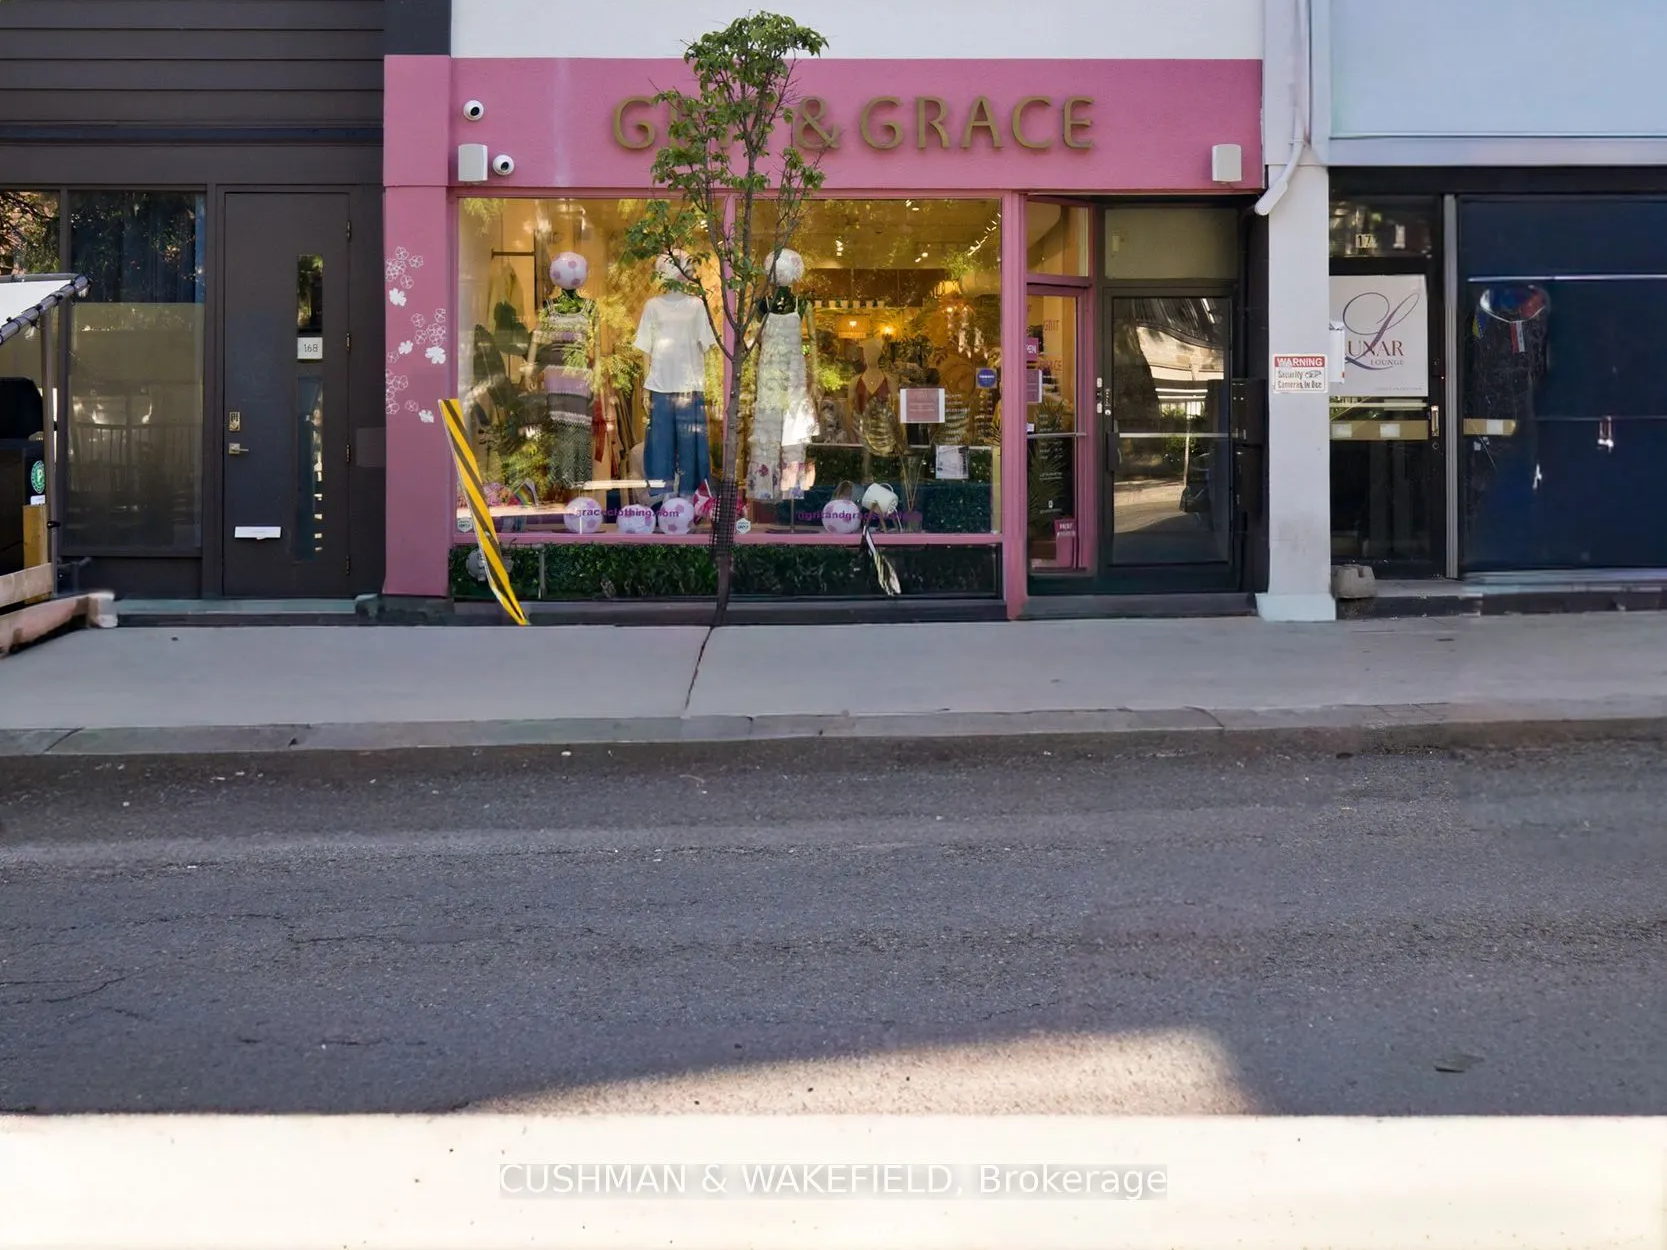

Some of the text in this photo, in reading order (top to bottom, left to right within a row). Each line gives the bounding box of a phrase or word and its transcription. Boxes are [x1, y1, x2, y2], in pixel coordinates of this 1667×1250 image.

[797, 96, 841, 149] &
[860, 96, 1095, 150] GRACE
[304, 343, 318, 353] 168
[1276, 357, 1323, 367] WARNING
[1278, 370, 1303, 380] Security
